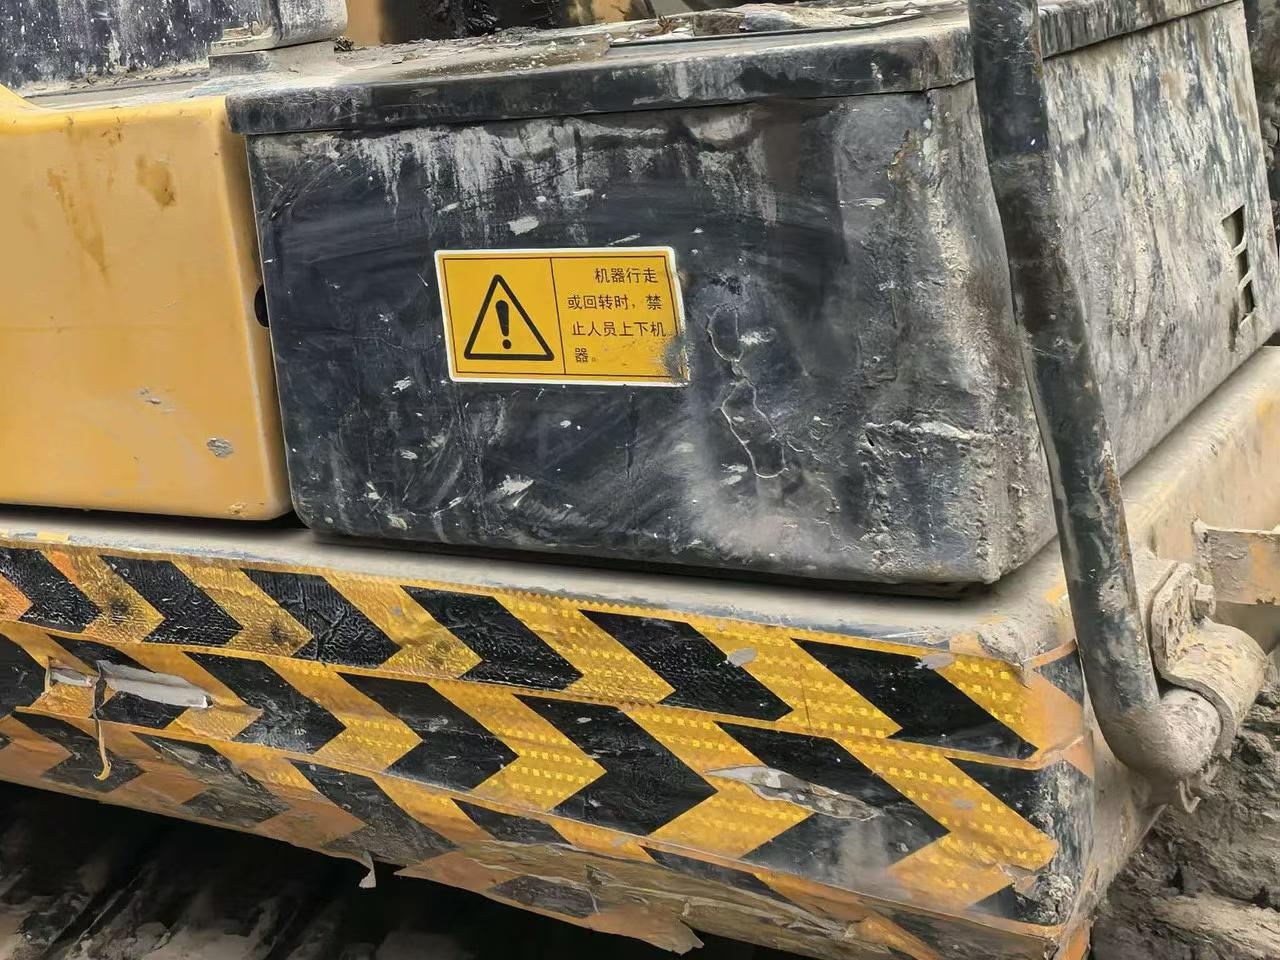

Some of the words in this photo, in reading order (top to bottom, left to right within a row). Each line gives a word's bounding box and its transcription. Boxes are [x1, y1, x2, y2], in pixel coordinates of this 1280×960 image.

[595, 267, 658, 283] 机器行走
[572, 321, 666, 337] 止人员上下机
